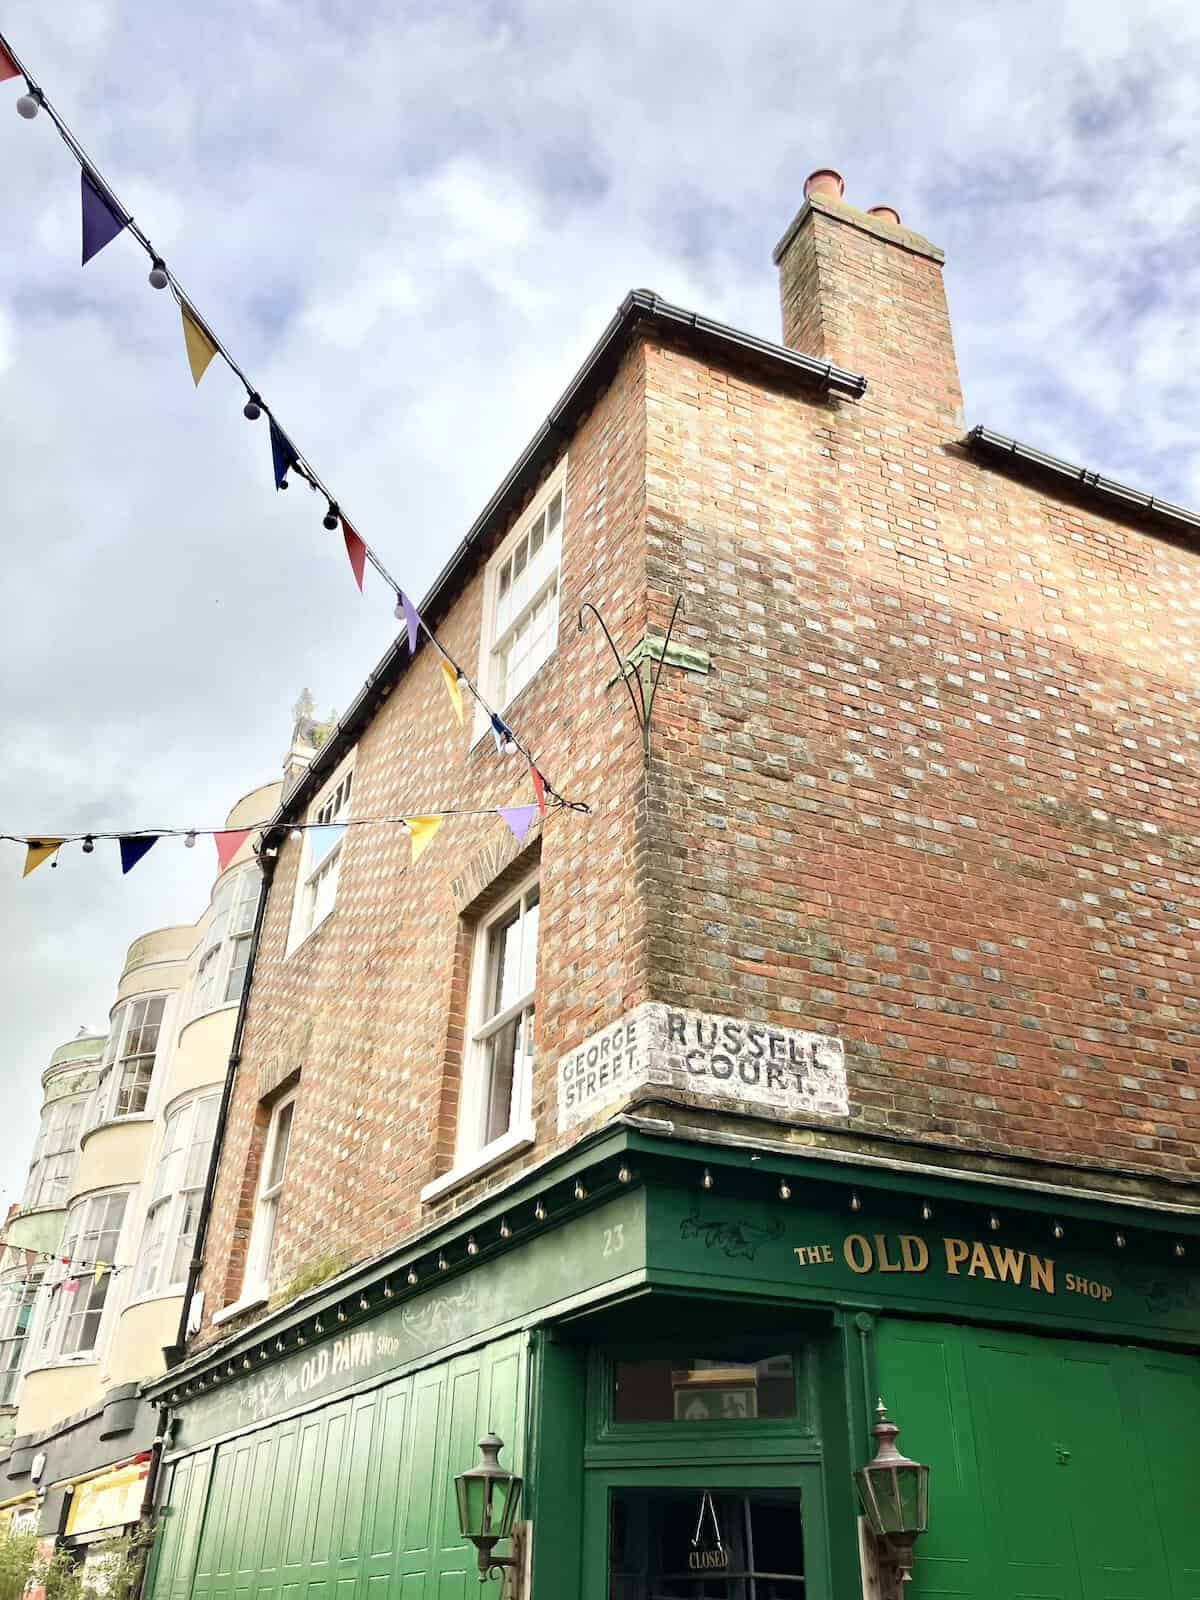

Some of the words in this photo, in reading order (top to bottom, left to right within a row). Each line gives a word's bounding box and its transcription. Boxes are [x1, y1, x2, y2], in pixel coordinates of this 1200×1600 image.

[562, 1019, 637, 1082] GEORGE
[667, 1012, 829, 1071] RUSSELL
[601, 1223, 625, 1257] 23
[794, 1244, 835, 1266] THE
[843, 1233, 930, 1275] OLD
[943, 1238, 1056, 1295] PAWN
[1065, 1273, 1113, 1303] SHOP
[301, 1349, 329, 1393] OLD
[331, 1331, 374, 1375] PAWN
[689, 1551, 728, 1569] CLOSED
